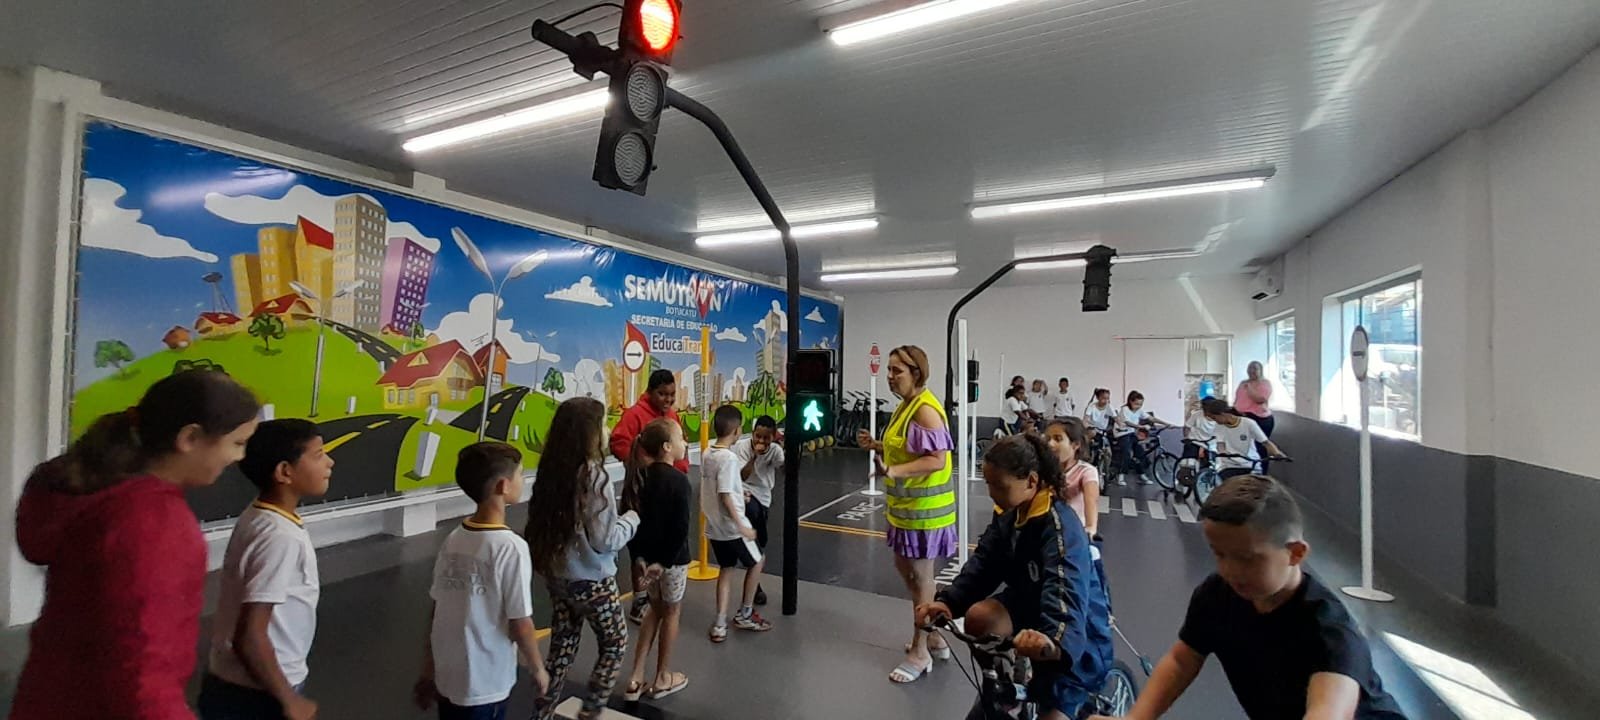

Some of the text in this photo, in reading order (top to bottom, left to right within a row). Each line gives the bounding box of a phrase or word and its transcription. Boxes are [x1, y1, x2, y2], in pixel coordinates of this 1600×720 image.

[624, 274, 721, 312] SEMUTRN
[665, 306, 697, 317] BOTUCATU
[631, 314, 675, 328] SECRETARIA
[676, 320, 686, 329] DE
[837, 502, 884, 520] PARE
